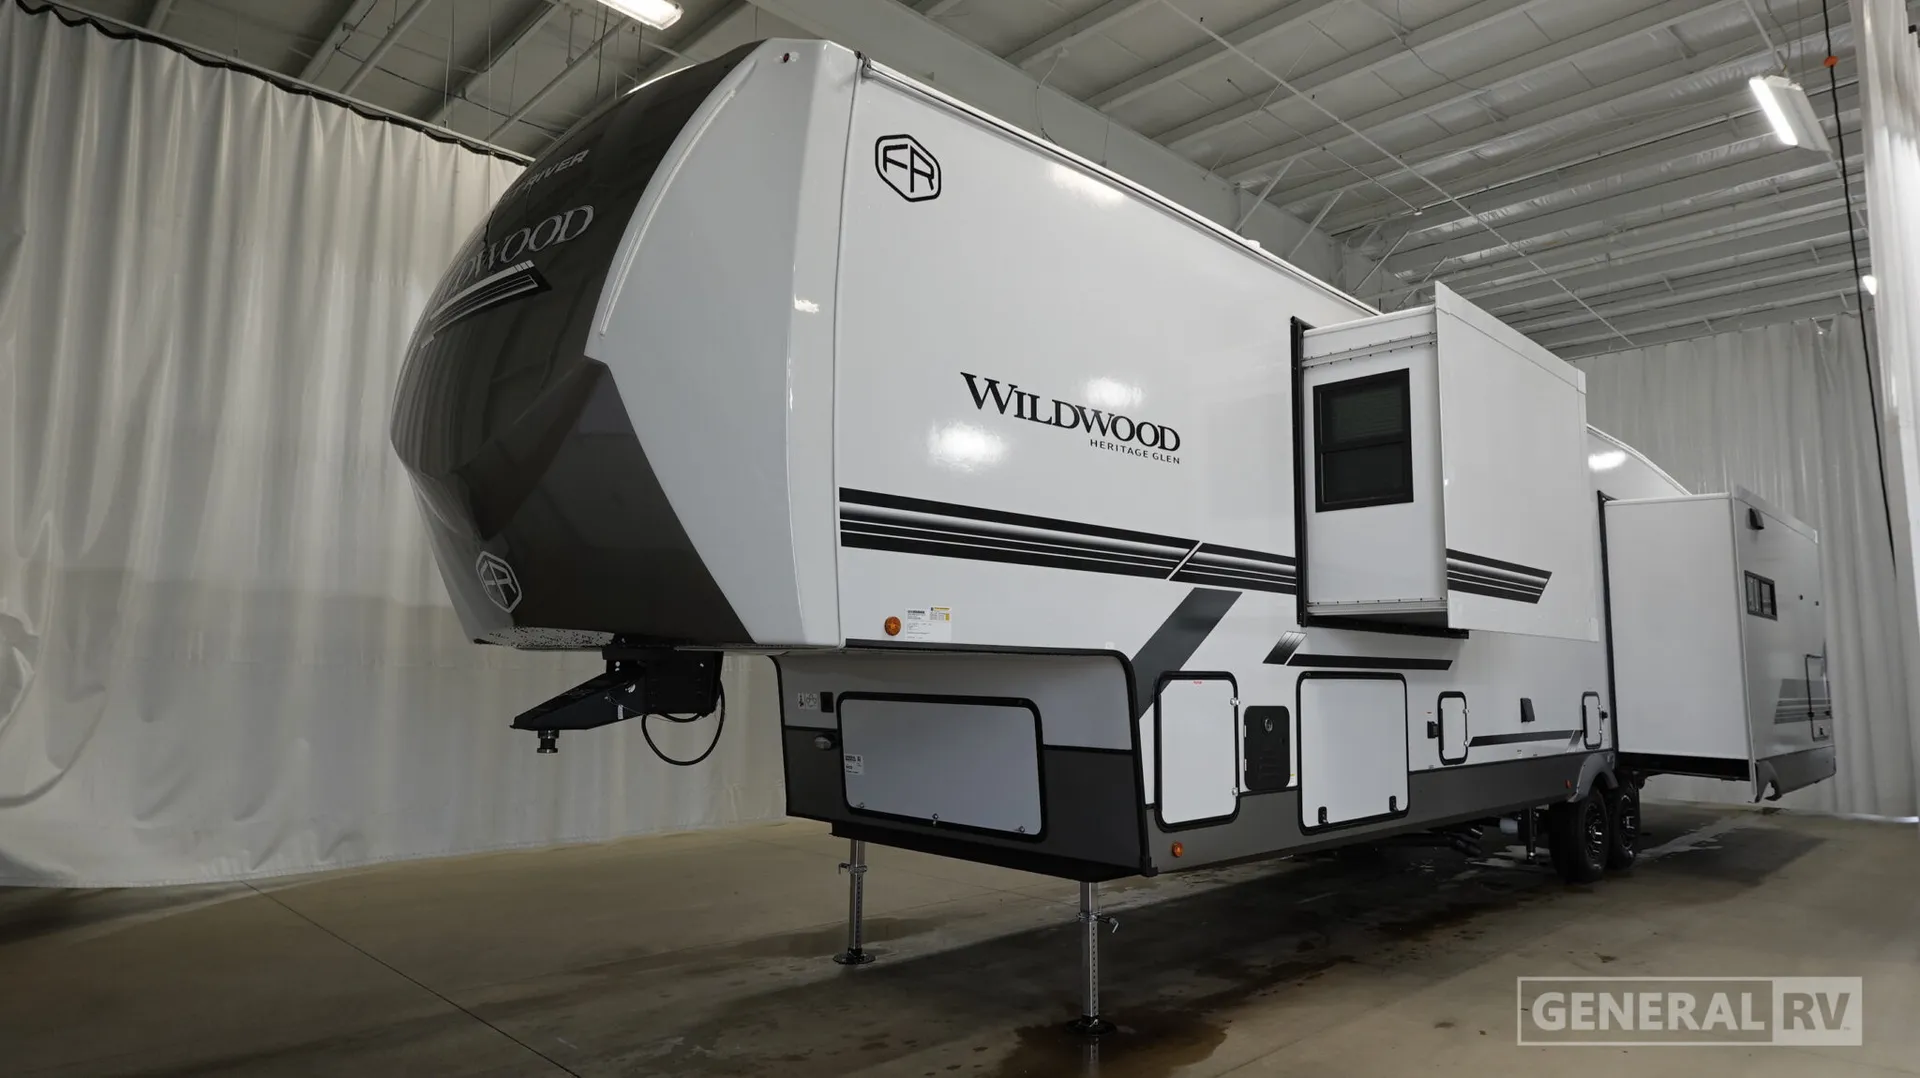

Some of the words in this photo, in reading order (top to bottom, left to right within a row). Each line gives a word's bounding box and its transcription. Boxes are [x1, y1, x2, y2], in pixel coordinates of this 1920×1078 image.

[882, 143, 935, 193] FR
[1090, 439, 1149, 459] HERITAGE
[1152, 452, 1181, 465] GLEN
